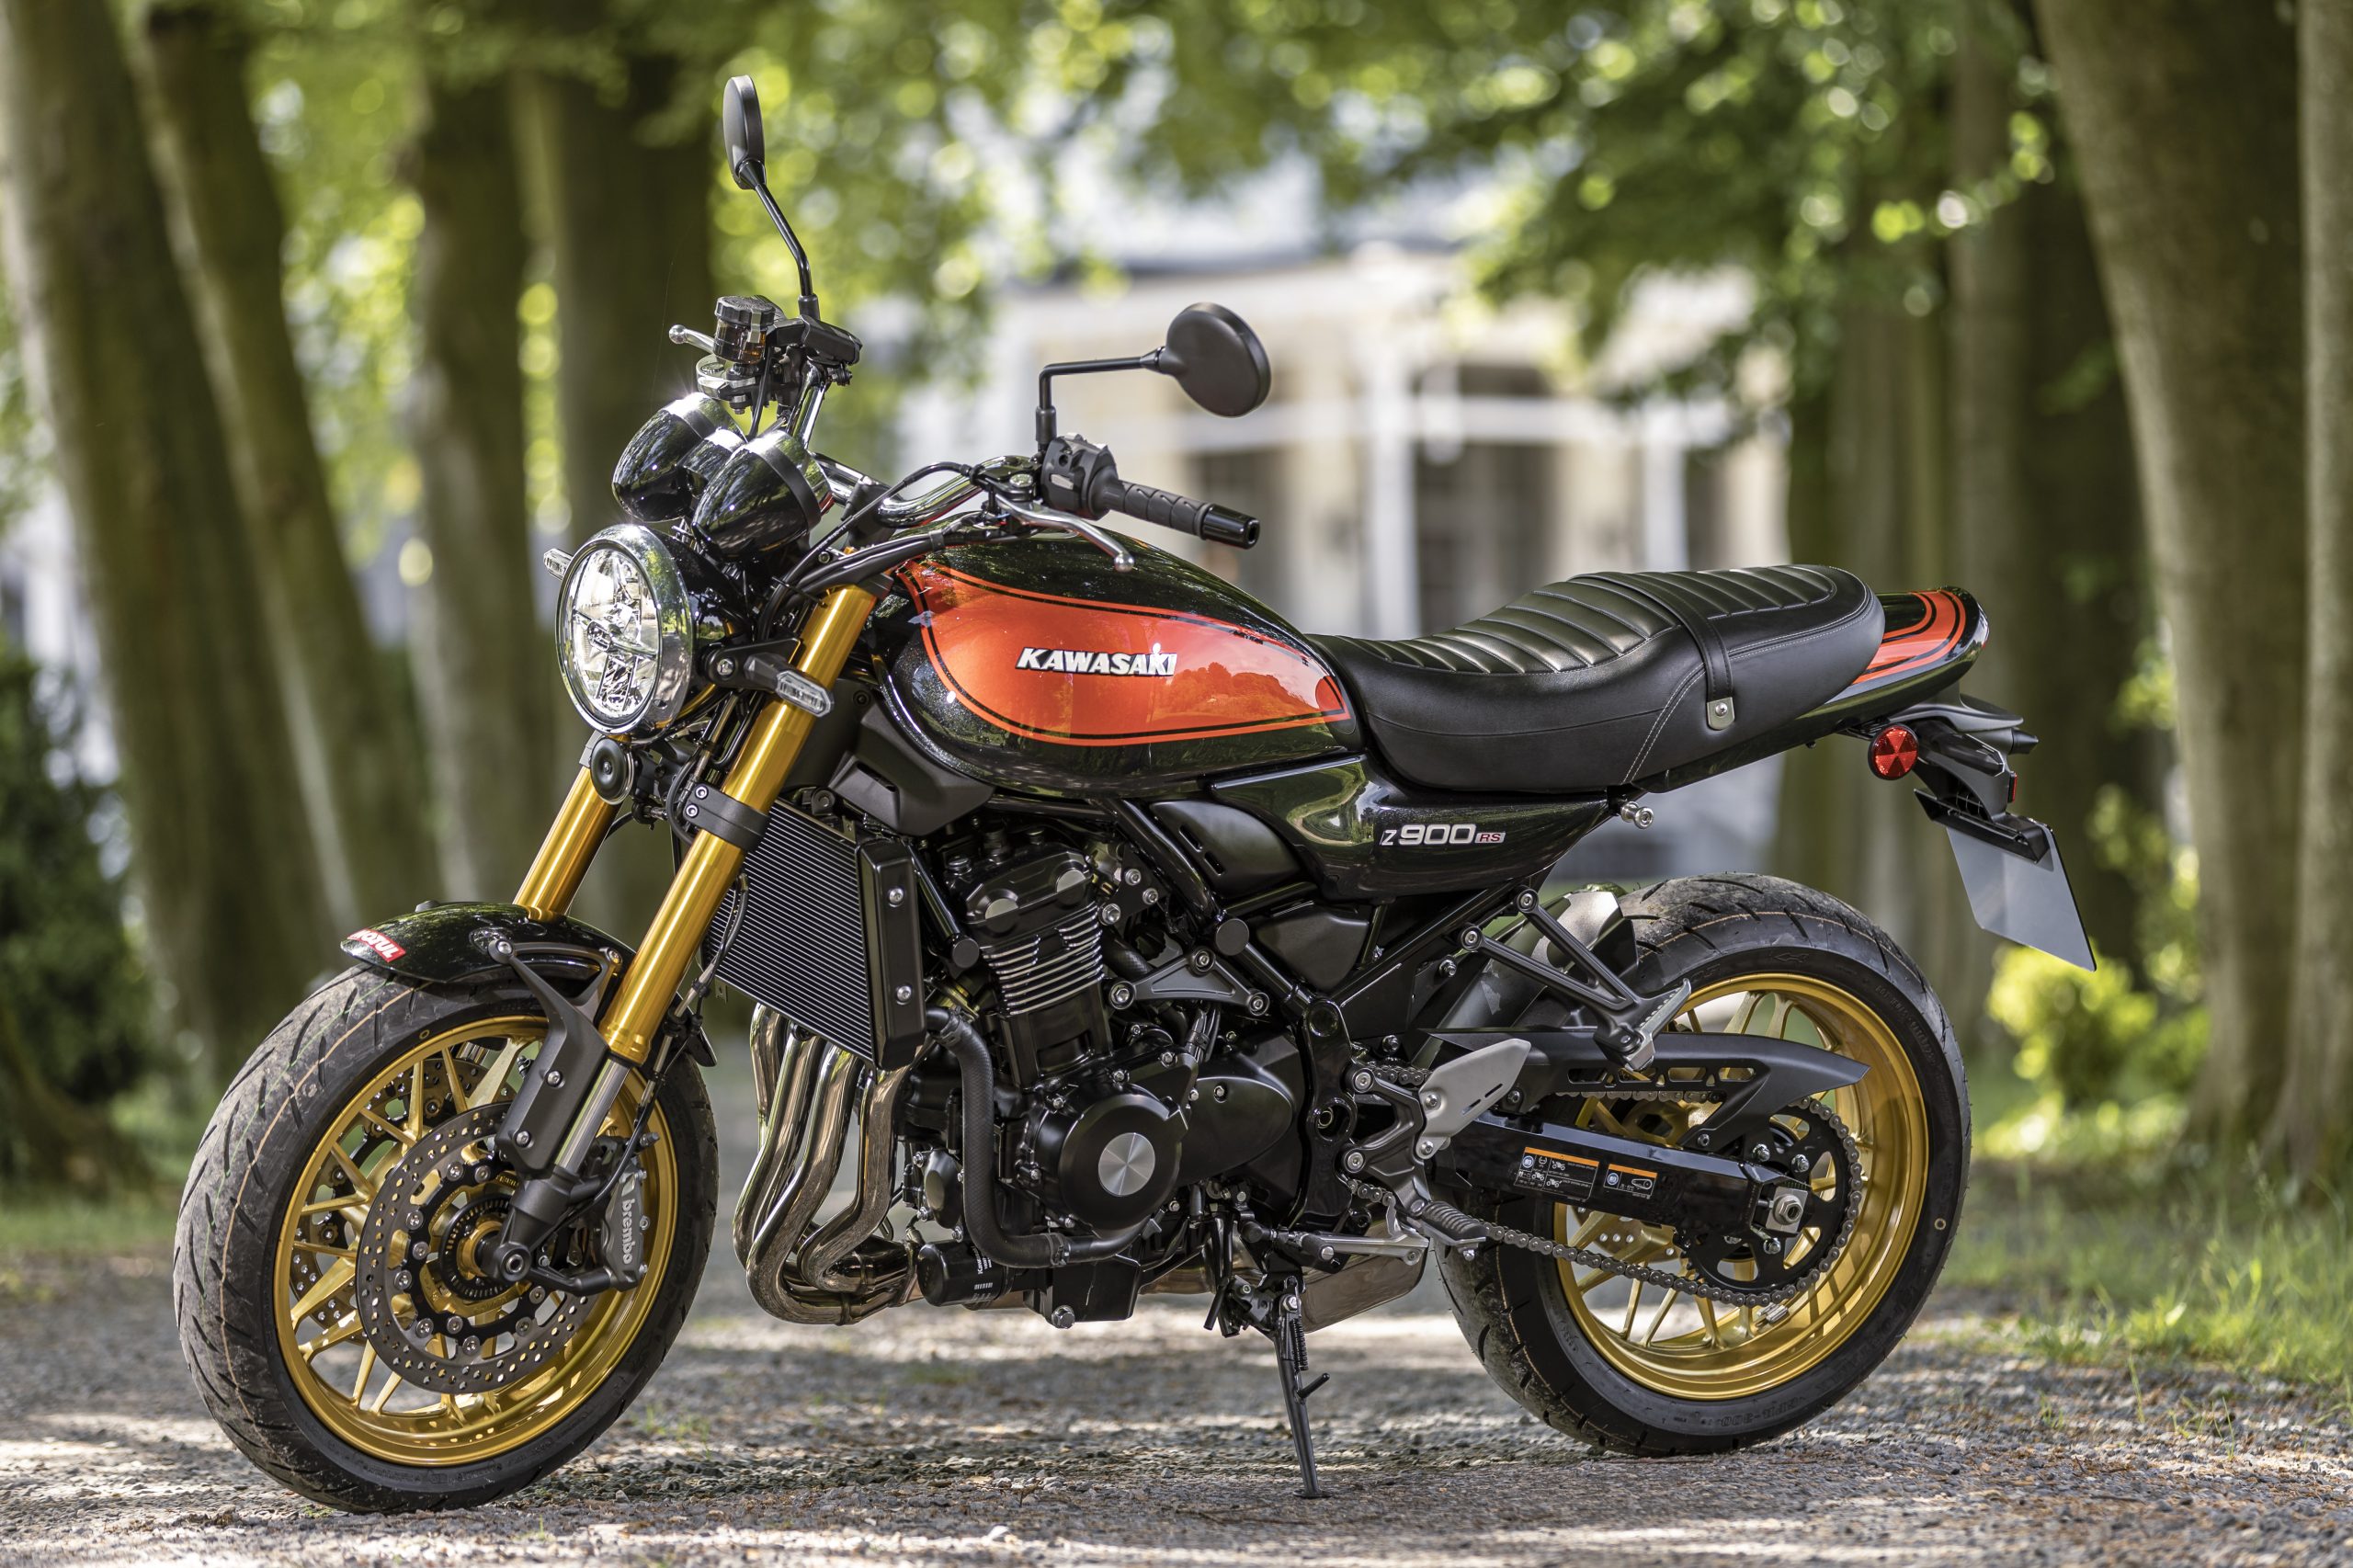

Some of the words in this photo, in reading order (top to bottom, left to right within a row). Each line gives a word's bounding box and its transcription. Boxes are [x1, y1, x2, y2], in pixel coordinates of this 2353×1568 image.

[1016, 646, 1177, 676] KAWASAKI
[1478, 833, 1502, 843] RS
[347, 928, 401, 959] MOTUL
[621, 1198, 636, 1265] brembo
